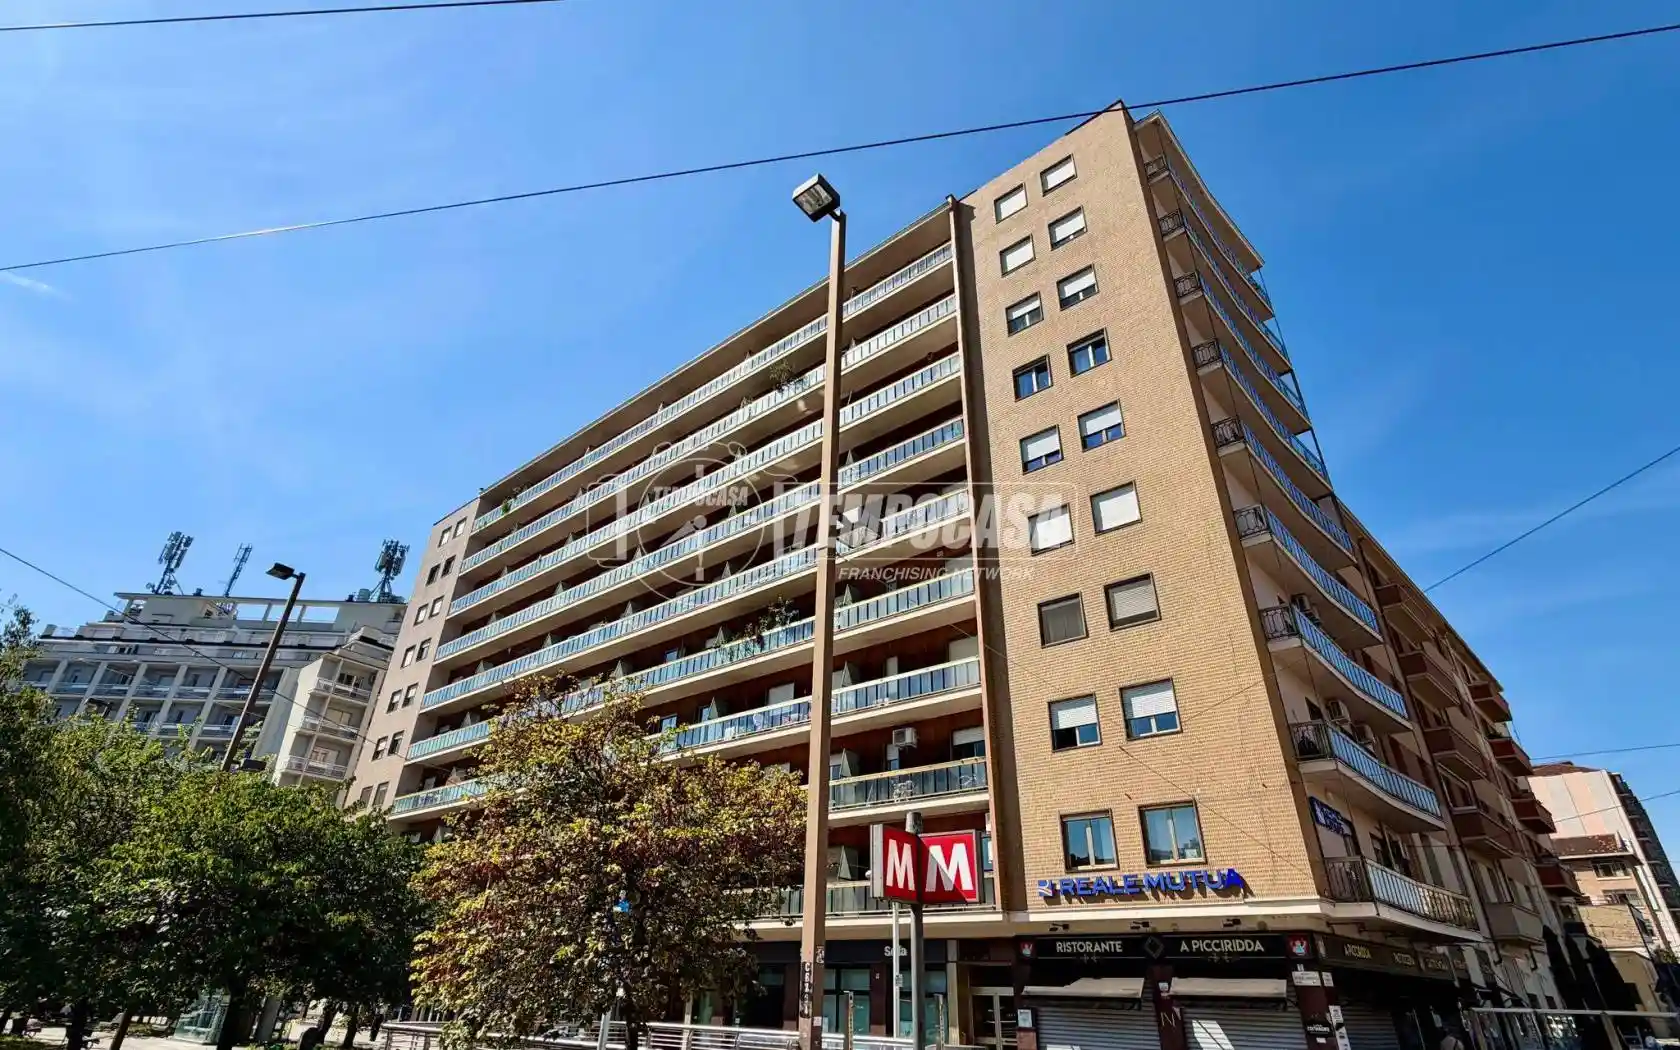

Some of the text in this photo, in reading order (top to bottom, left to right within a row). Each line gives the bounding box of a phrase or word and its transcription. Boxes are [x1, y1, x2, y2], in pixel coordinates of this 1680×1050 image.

[886, 839, 915, 891] M
[924, 842, 974, 892] M
[1060, 868, 1243, 896] REALE MUTUA
[1056, 941, 1123, 953] RISTORANTE
[1180, 939, 1265, 953] A PICCIRIDDA
